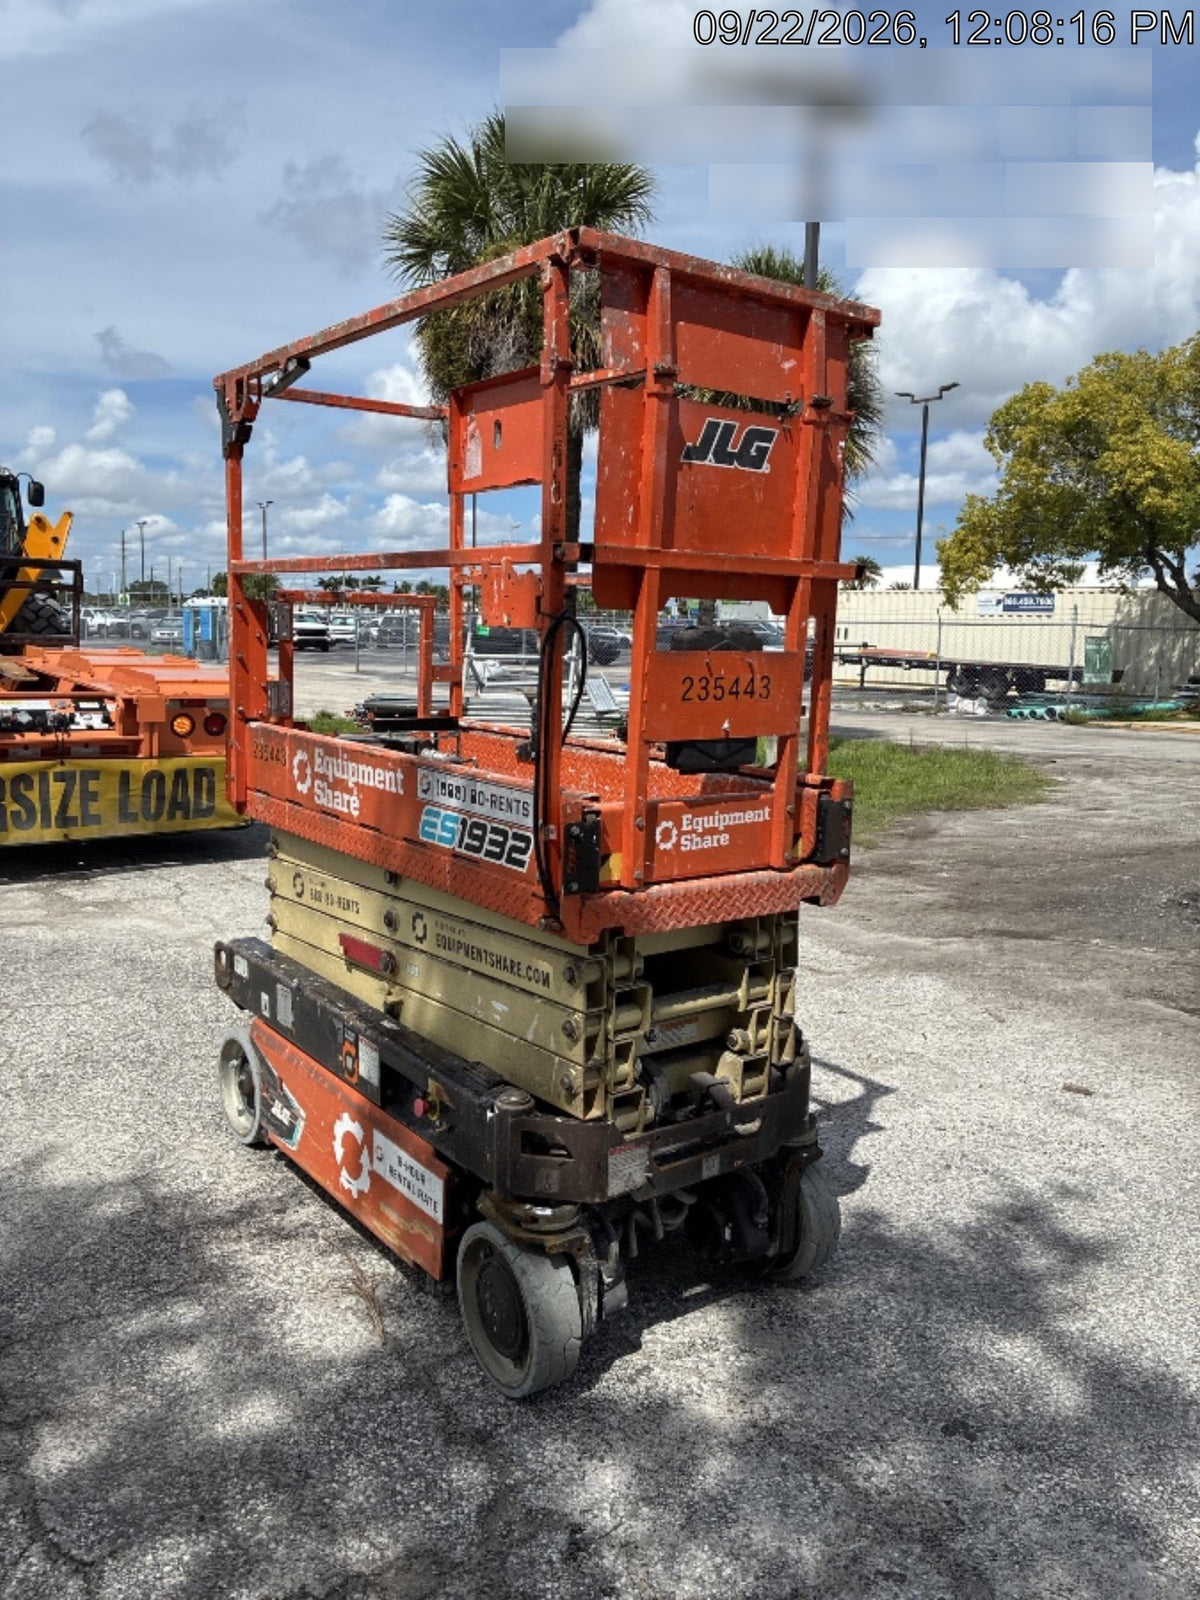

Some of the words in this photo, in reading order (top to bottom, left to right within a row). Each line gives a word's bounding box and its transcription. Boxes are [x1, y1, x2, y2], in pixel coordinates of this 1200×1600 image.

[681, 417, 779, 473] JLG
[682, 675, 771, 701] 235443
[118, 767, 216, 823] LOAD
[314, 747, 404, 795] Equipment
[314, 779, 360, 817] Share
[682, 806, 771, 832] Equipment
[419, 805, 534, 873] ES1932
[681, 833, 730, 851] Share
[435, 932, 550, 989] EQUIPMENTSHARE.COM
